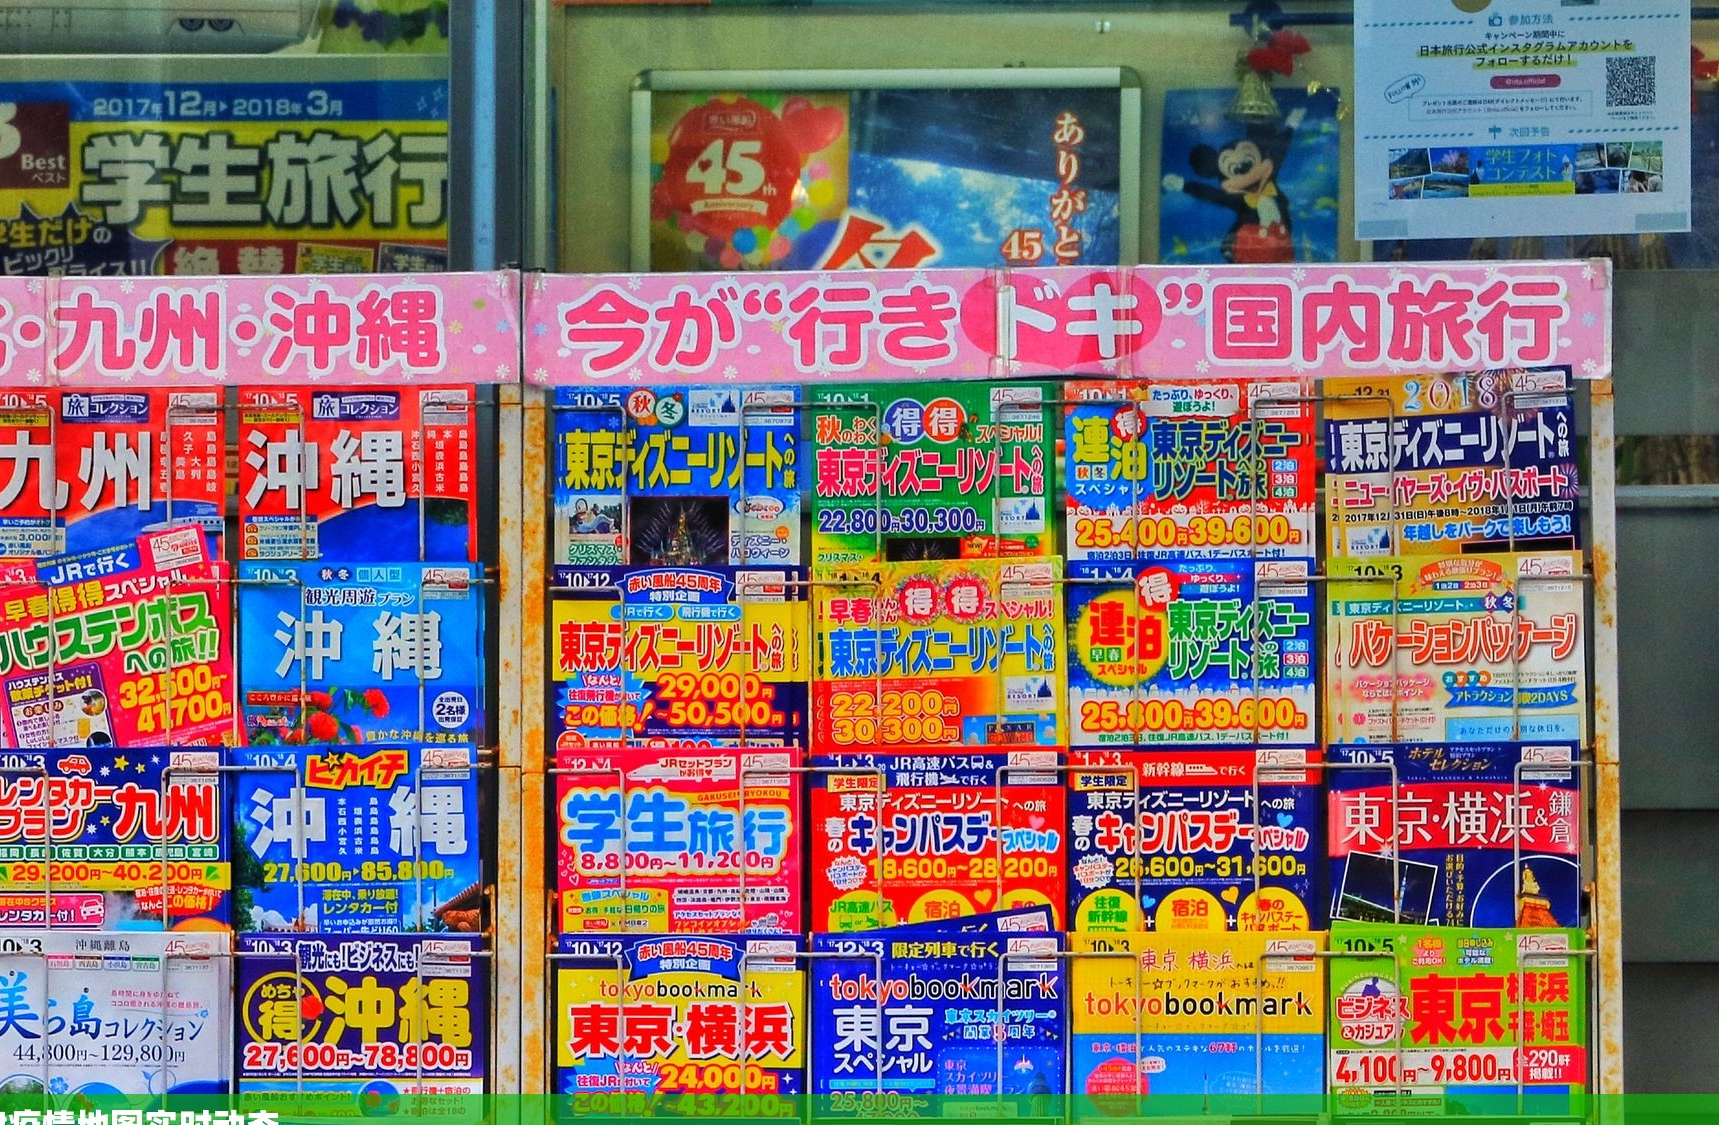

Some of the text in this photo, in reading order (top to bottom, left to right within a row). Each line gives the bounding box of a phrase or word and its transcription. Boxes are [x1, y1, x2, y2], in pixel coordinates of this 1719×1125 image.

[1508, 14, 1553, 25] 参加方法
[1419, 40, 1632, 57] 日本旅行公式インスタグラムアカウントを
[1485, 30, 1565, 40] キャンペーン期間中に
[1509, 126, 1550, 137] 次回予告
[21, 154, 66, 171] Best
[1487, 167, 1556, 180] コンテスト
[32, 172, 67, 183] ベスト
[82, 132, 448, 225] 学生旅行
[1152, 421, 1301, 461] 東京ディズニー
[1340, 413, 1556, 470] 東京ディズニーリゾート
[244, 430, 406, 509] 沖縄
[565, 430, 783, 491] 東京ディズニーリゾート
[817, 448, 1031, 496] 東京ディズニーリゾート
[1153, 460, 1237, 500] リゾート
[51, 556, 130, 584] JRで行く
[628, 573, 722, 593] 赤い風船45周年
[305, 587, 415, 607] 観光周遊プラン
[649, 592, 701, 603] 特別企画
[682, 605, 737, 619] 飛行機で行く
[1168, 602, 1310, 641] 東京ディズニー
[273, 610, 444, 681] 沖縄
[559, 621, 771, 672] 東京ディズニーリゾート
[829, 627, 1042, 677] 東京ディズニーリゾート
[1349, 615, 1576, 667] バケーションパッケージ
[1170, 639, 1252, 680] リゾート
[656, 674, 773, 700] 29,000円
[305, 751, 410, 790] ピカイチ
[659, 758, 733, 770] JRセットプラン
[1080, 774, 1127, 787] 学生限定
[114, 783, 217, 841] 九州
[839, 794, 1010, 812] 東京ディズニーリゾート
[1086, 792, 1254, 810] 東京ディズニーリゾート
[565, 791, 788, 855] 学生旅行
[93, 847, 116, 859] 大分
[75, 938, 131, 952] 沖縄離島
[891, 941, 1000, 959] 限定列車で行く
[599, 979, 762, 1001] tokyobookmark
[829, 974, 1058, 1005] tokyobookmark
[1507, 974, 1569, 1004] 横浜
[323, 976, 472, 1046] 沖縄
[1085, 991, 1313, 1018] tokyobookmark
[1336, 996, 1410, 1020] ビジネス
[1409, 975, 1505, 1044] 東京
[568, 1003, 794, 1059] 東京・横浜
[660, 1064, 776, 1090] 24,000円
